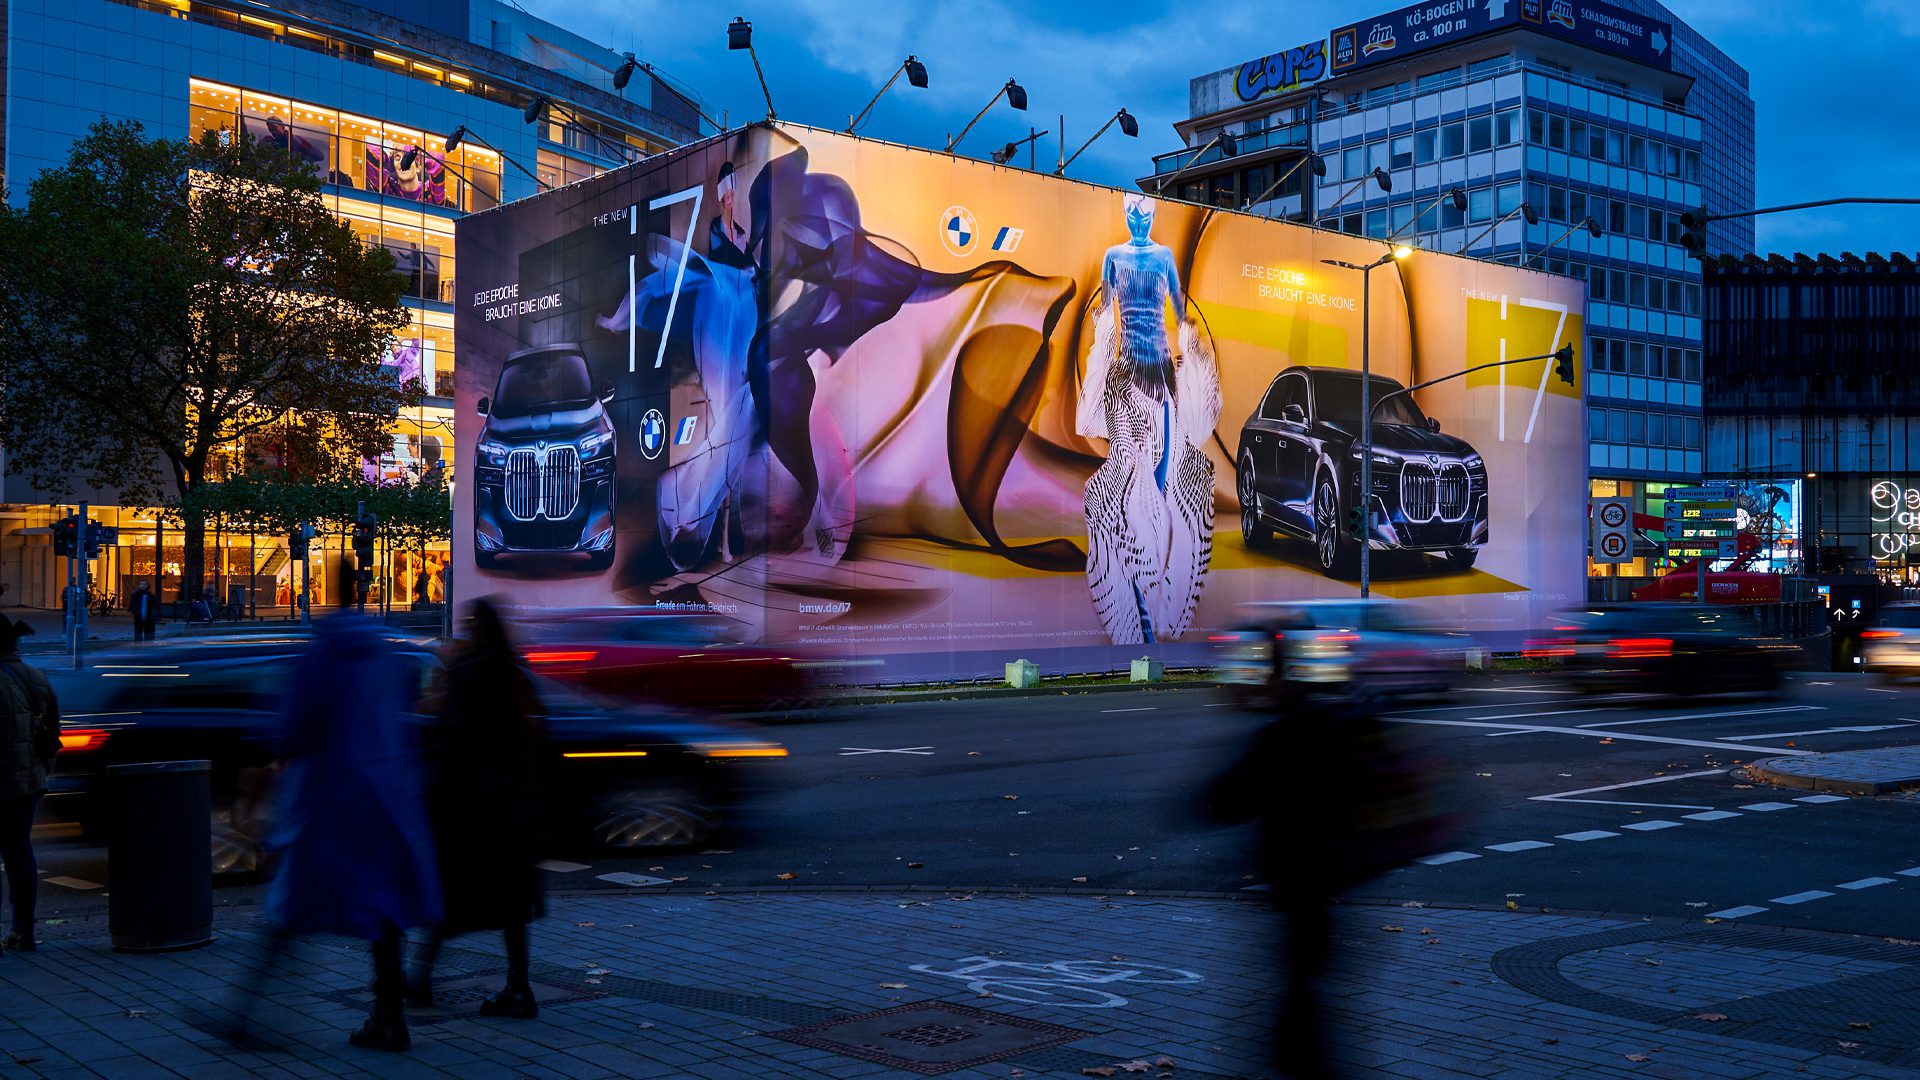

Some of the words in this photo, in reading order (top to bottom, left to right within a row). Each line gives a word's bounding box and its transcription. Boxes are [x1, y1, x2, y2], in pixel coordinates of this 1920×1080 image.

[1406, 0, 1463, 27] KÖ-BOGEN
[1525, 3, 1539, 14] ALDI
[1413, 31, 1429, 42] ca.
[1432, 21, 1452, 37] 100
[1455, 18, 1467, 31] m
[1581, 8, 1643, 37] SCHADOWSTRASSE
[1595, 28, 1606, 39] ca.
[1607, 29, 1621, 42] 300
[1621, 37, 1629, 47] m
[1337, 49, 1353, 60] ALDI
[1236, 39, 1327, 102] COPS
[593, 213, 609, 228] THE
[610, 207, 628, 223] NEW
[629, 185, 704, 373] i7
[1241, 263, 1265, 279] JEDE
[1267, 267, 1305, 286] EPOCHE
[474, 291, 490, 307] JEDE
[490, 284, 519, 302] EPOCHE
[1259, 284, 1304, 303] BRAUCHT
[1307, 292, 1328, 307] EINE
[1329, 296, 1358, 311] IKONE.
[486, 303, 518, 322] BRAUCHT
[519, 299, 537, 315] EINE
[537, 293, 562, 311] IKONE.
[1461, 287, 1477, 299] THE
[1479, 292, 1498, 302] NEW
[1499, 294, 1569, 444] i7
[1683, 510, 1700, 518] 1232
[1700, 529, 1716, 537] FREI
[656, 600, 676, 611] Freude
[708, 602, 739, 614] Elektrisch.
[799, 602, 851, 613] bmw.de/i7
